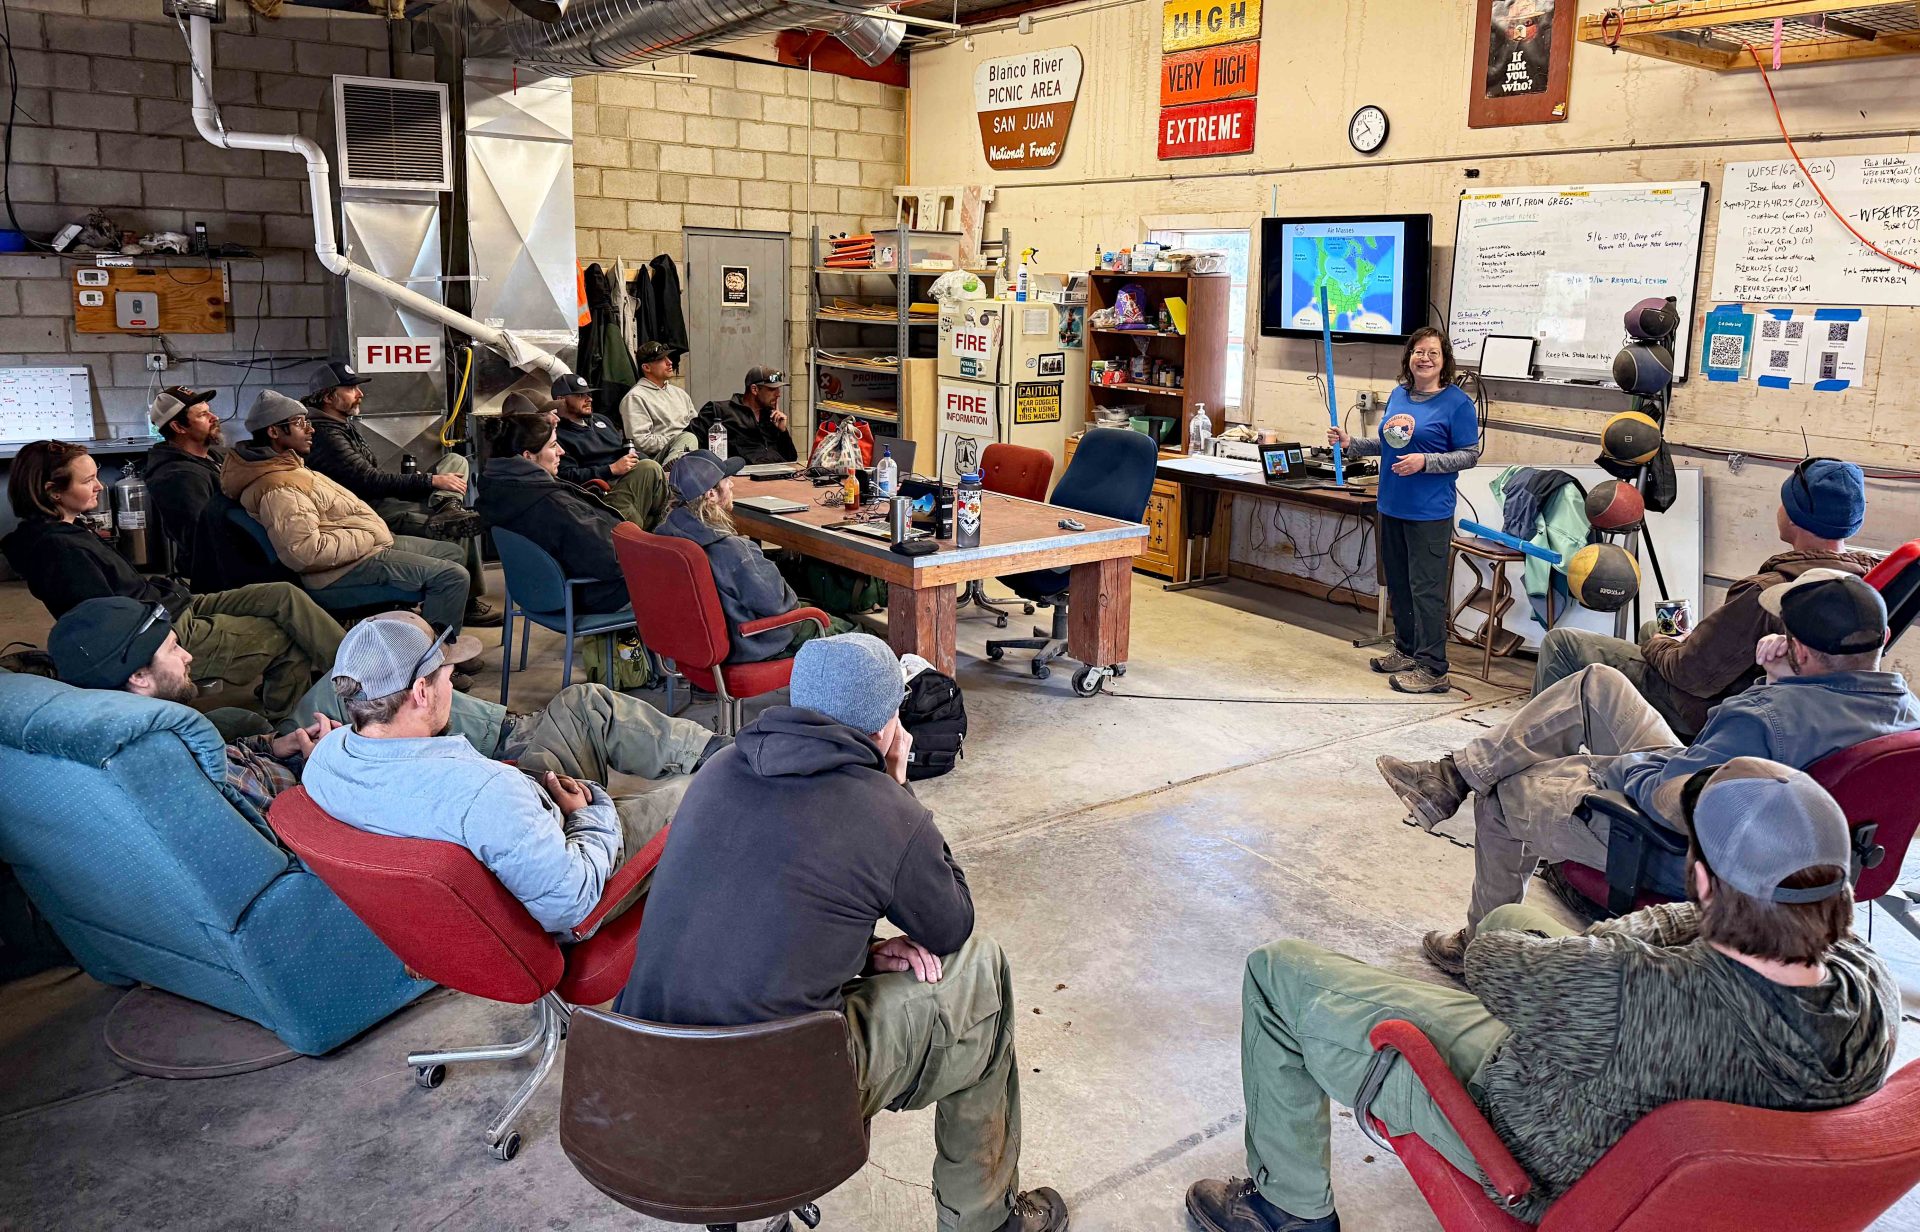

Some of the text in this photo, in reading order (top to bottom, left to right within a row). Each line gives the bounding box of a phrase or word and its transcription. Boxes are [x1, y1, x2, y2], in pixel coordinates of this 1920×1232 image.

[1173, 1, 1247, 39] HIGH
[1512, 51, 1523, 62] If
[989, 57, 1063, 81] Blanco River
[1169, 54, 1247, 93] VERY HIGH
[1507, 61, 1526, 71] not
[1505, 71, 1530, 83] you,
[988, 79, 1061, 104] PICNIC AREA
[1501, 79, 1533, 93] who?
[993, 110, 1054, 134] SAN JUAN
[1166, 112, 1242, 146] EXTREME
[989, 141, 1057, 162] National Forest
[1771, 181, 1787, 190] Hours
[1488, 201, 1497, 209] TO
[1524, 198, 1544, 207] FROM
[1547, 197, 1574, 207] GREG:
[955, 333, 987, 352] FIRE
[367, 345, 432, 364] FIRE
[1019, 385, 1059, 397] CAUTION
[947, 393, 987, 414] FIRE
[1035, 398, 1058, 406] GOGGLES
[946, 411, 988, 426] INFORMATION
[1033, 412, 1058, 420] MACHINE
